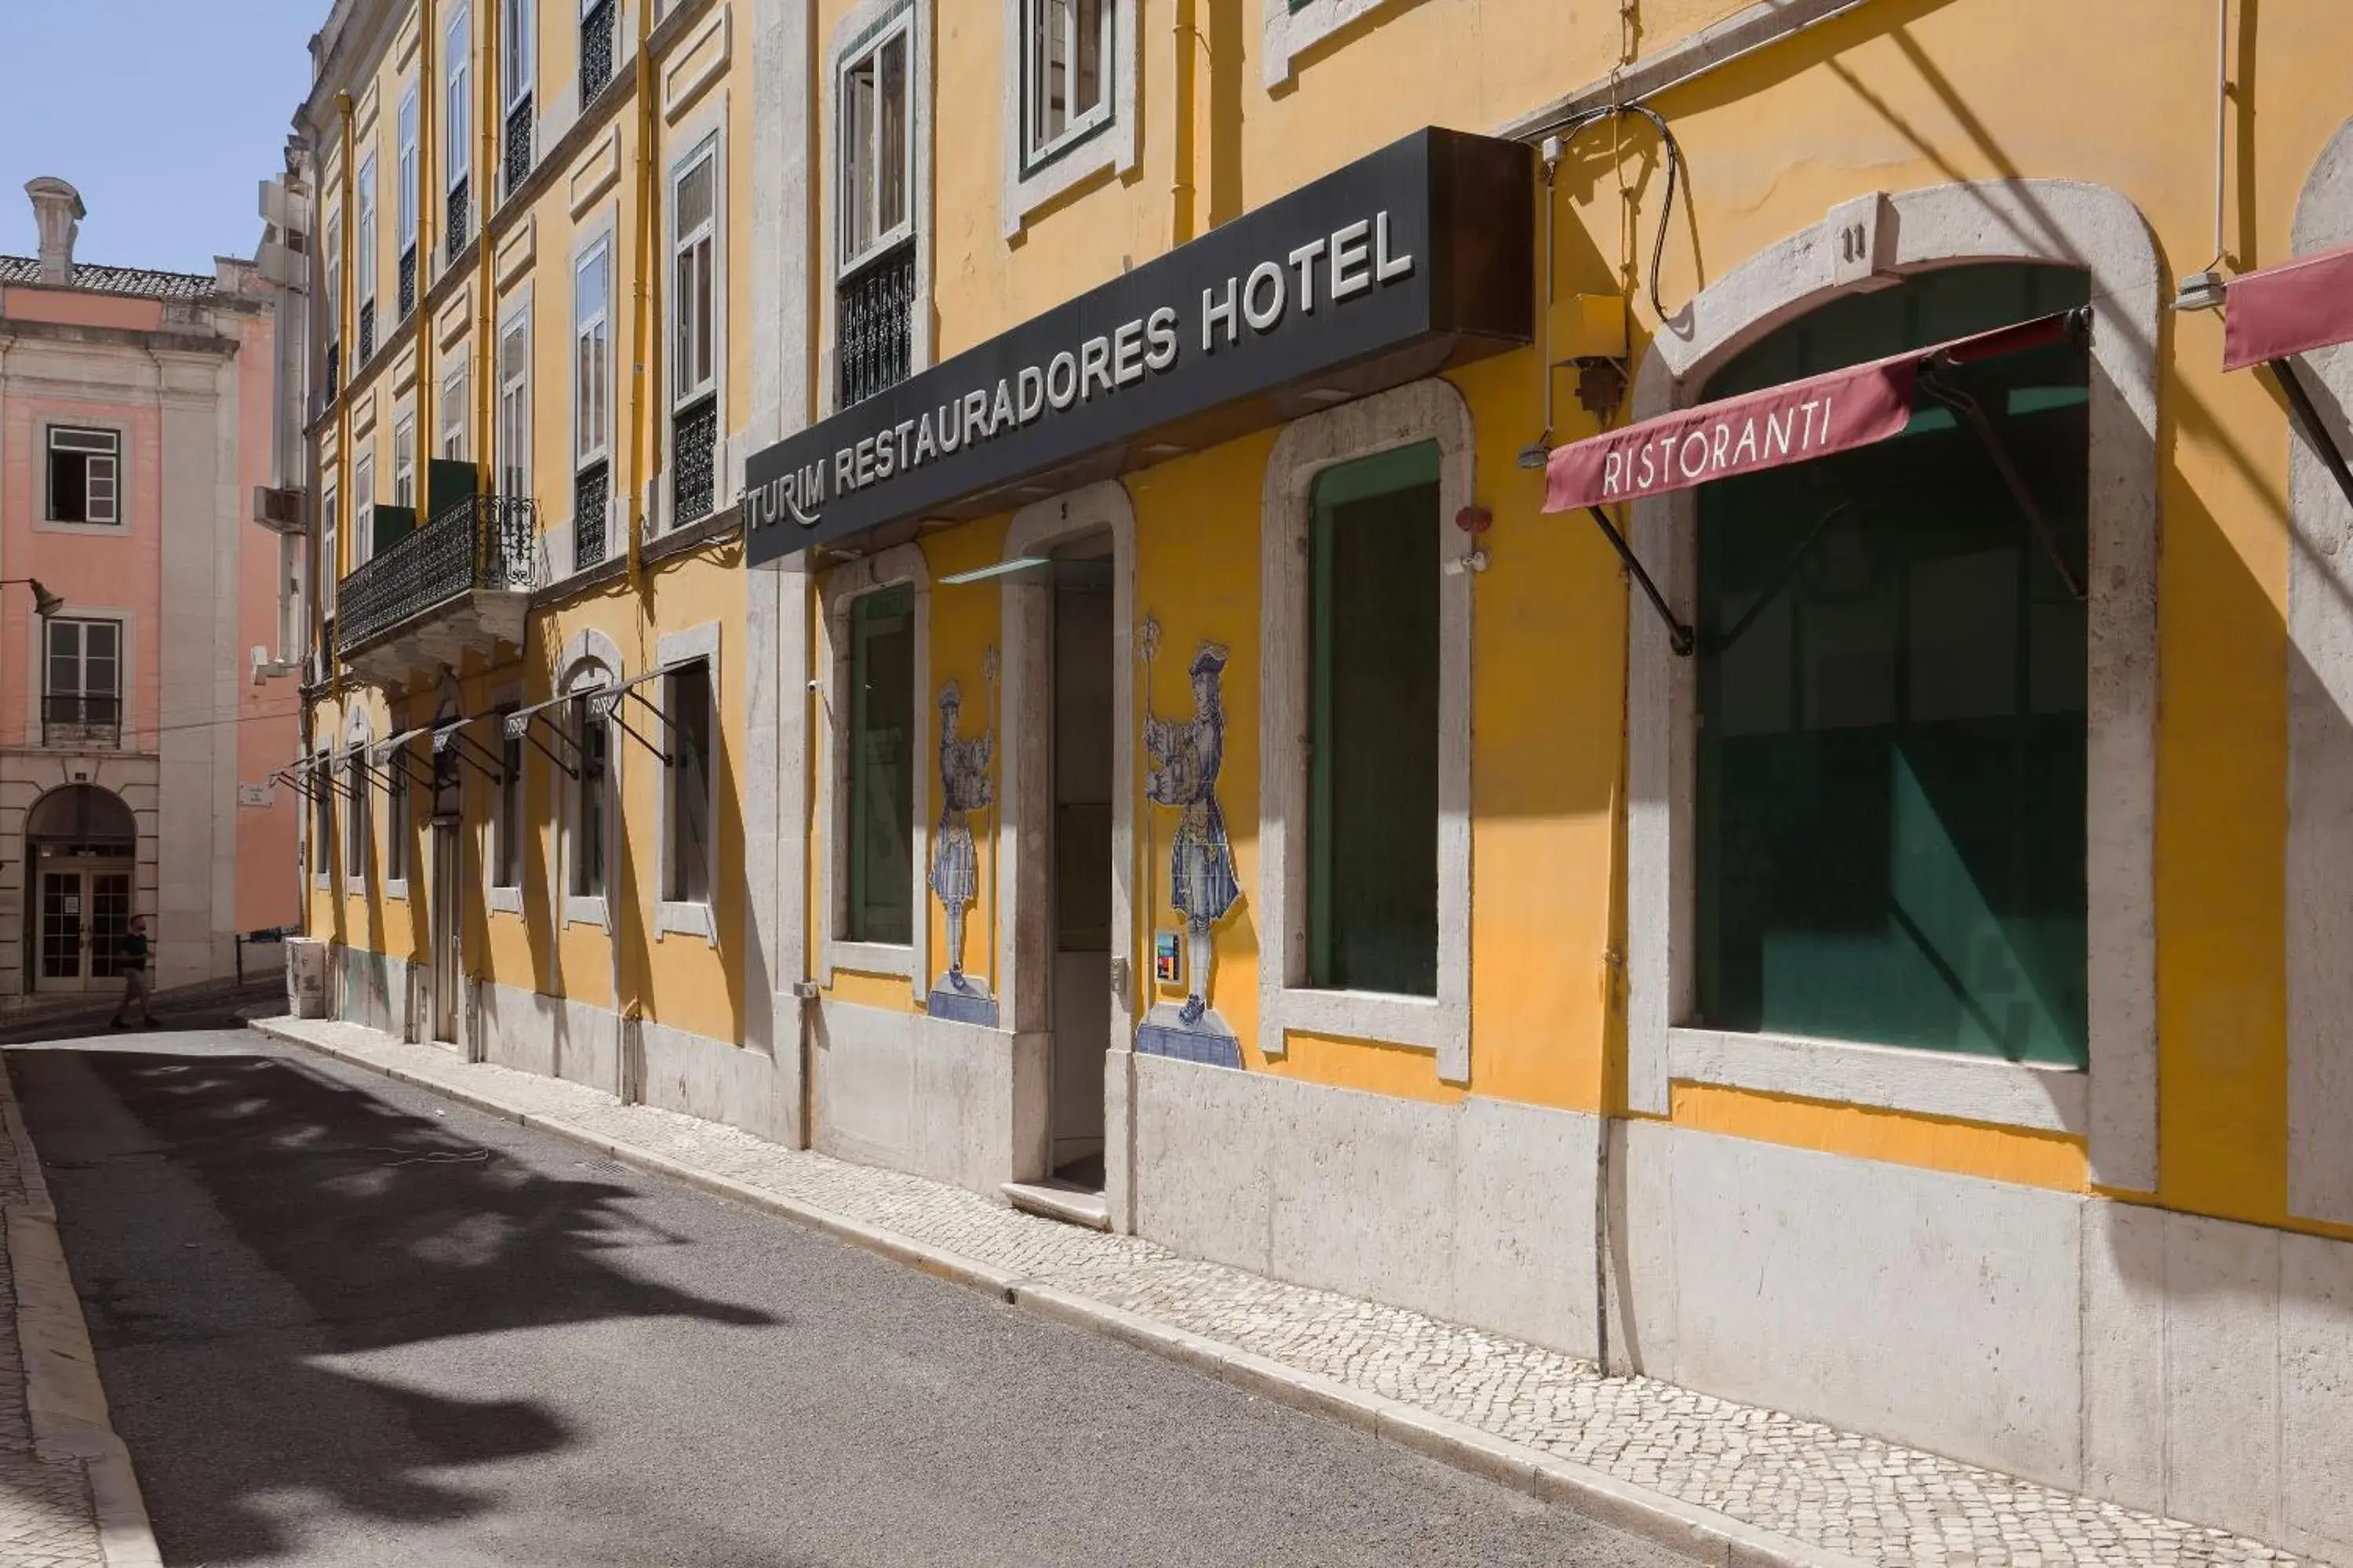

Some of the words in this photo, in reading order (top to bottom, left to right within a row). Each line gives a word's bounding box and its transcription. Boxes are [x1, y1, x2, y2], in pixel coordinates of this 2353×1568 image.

[748, 459, 826, 529] TURIM
[836, 307, 1178, 496] RESTAURADORES
[1202, 210, 1413, 351] HOTEL
[1603, 397, 1831, 496] RISTORANTI
